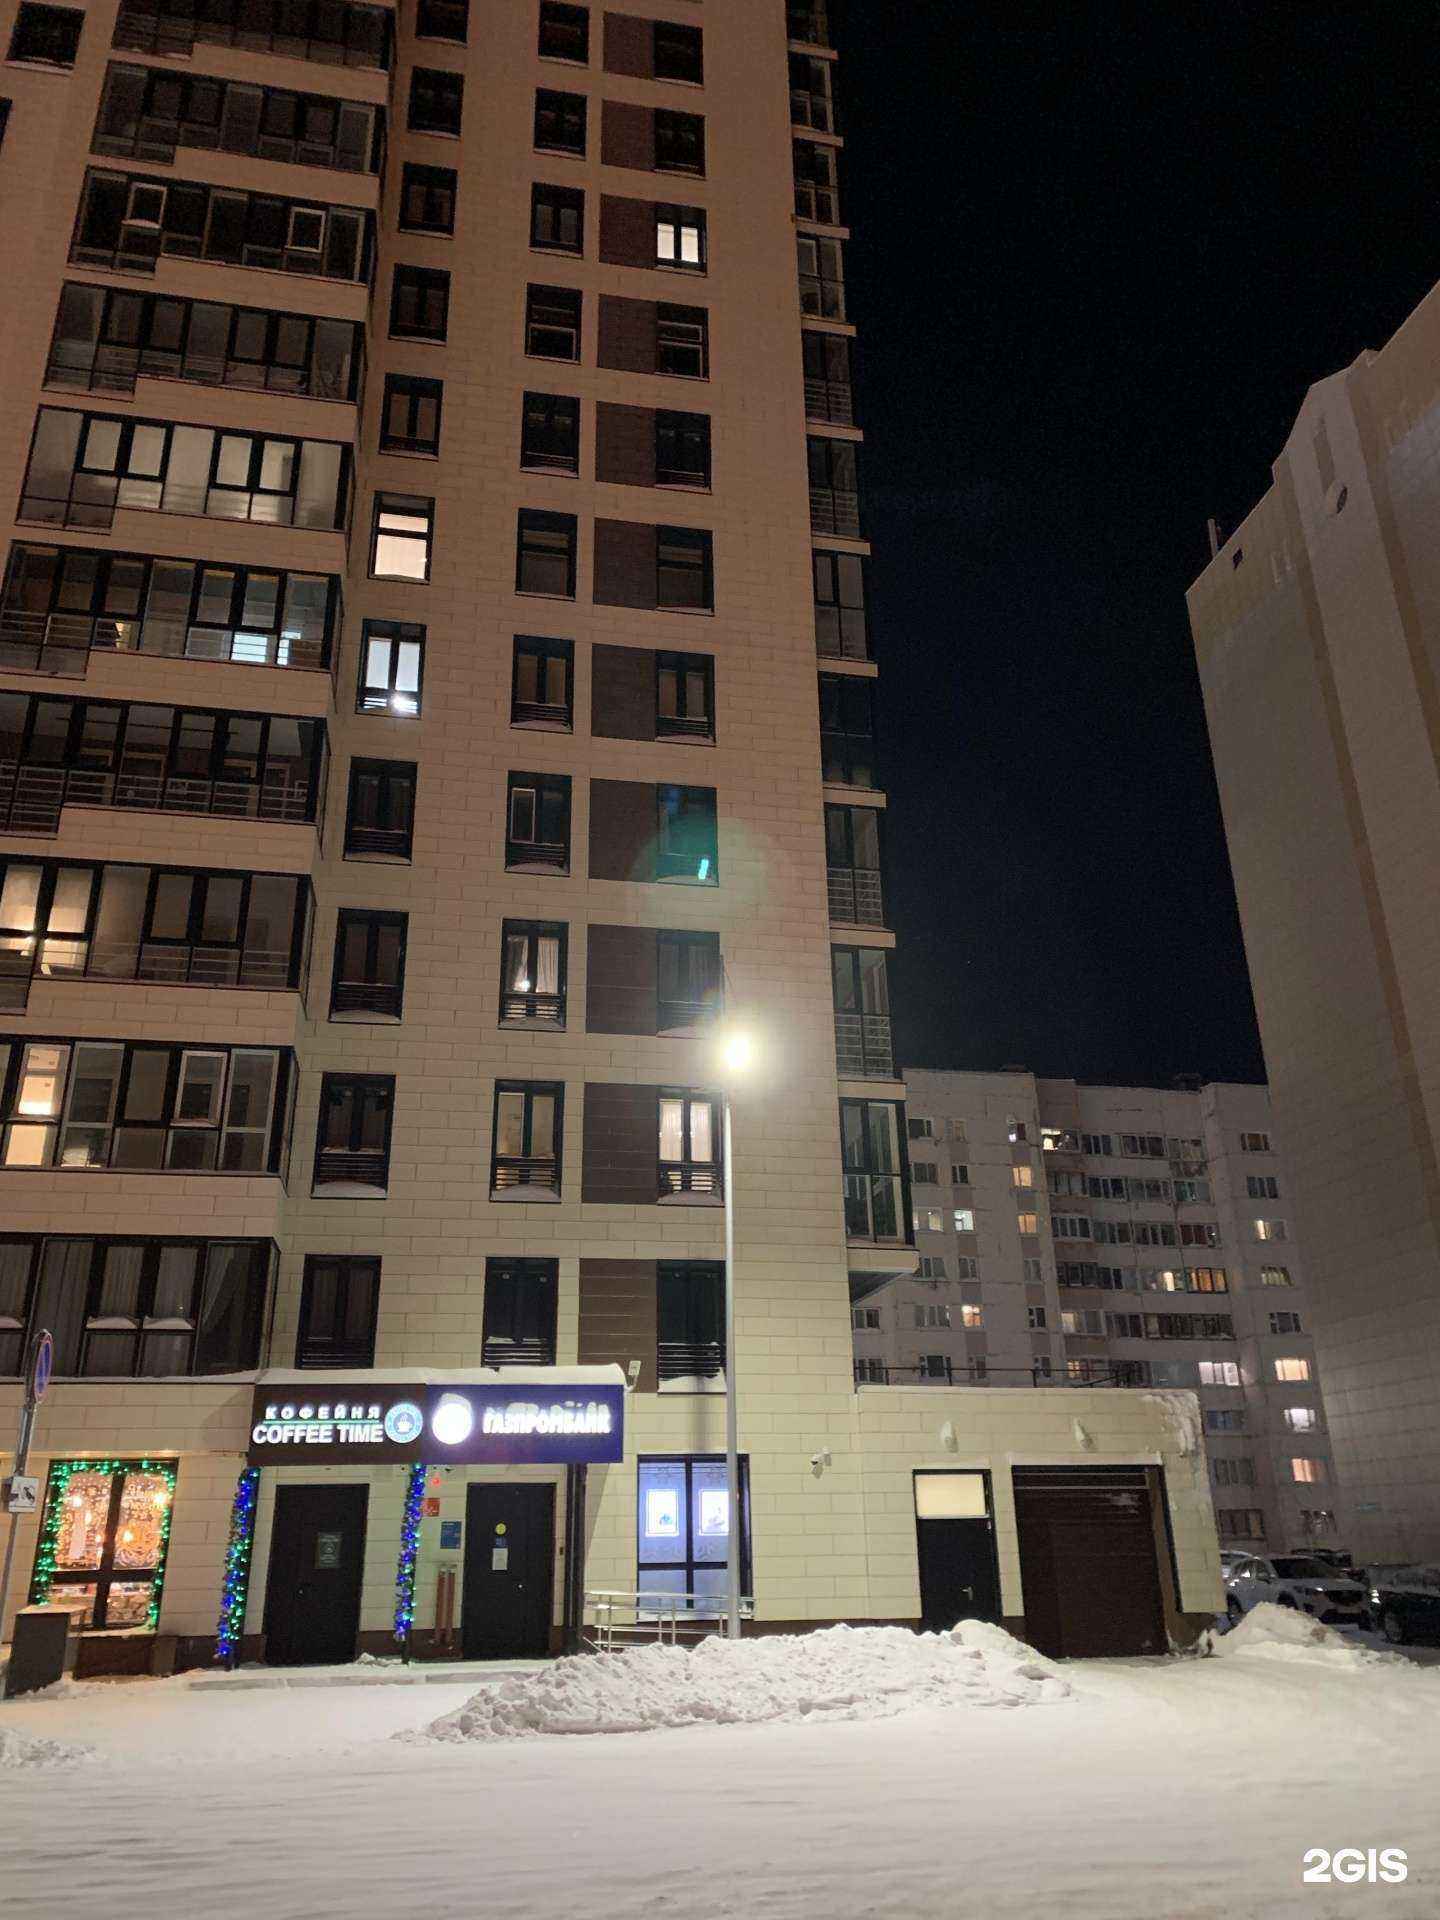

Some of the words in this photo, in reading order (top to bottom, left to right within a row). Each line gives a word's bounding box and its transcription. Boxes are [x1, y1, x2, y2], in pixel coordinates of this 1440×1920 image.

[265, 1404, 380, 1419] КОФЕЙНЯ
[252, 1424, 332, 1443] COFFEE
[336, 1424, 384, 1443] TIME
